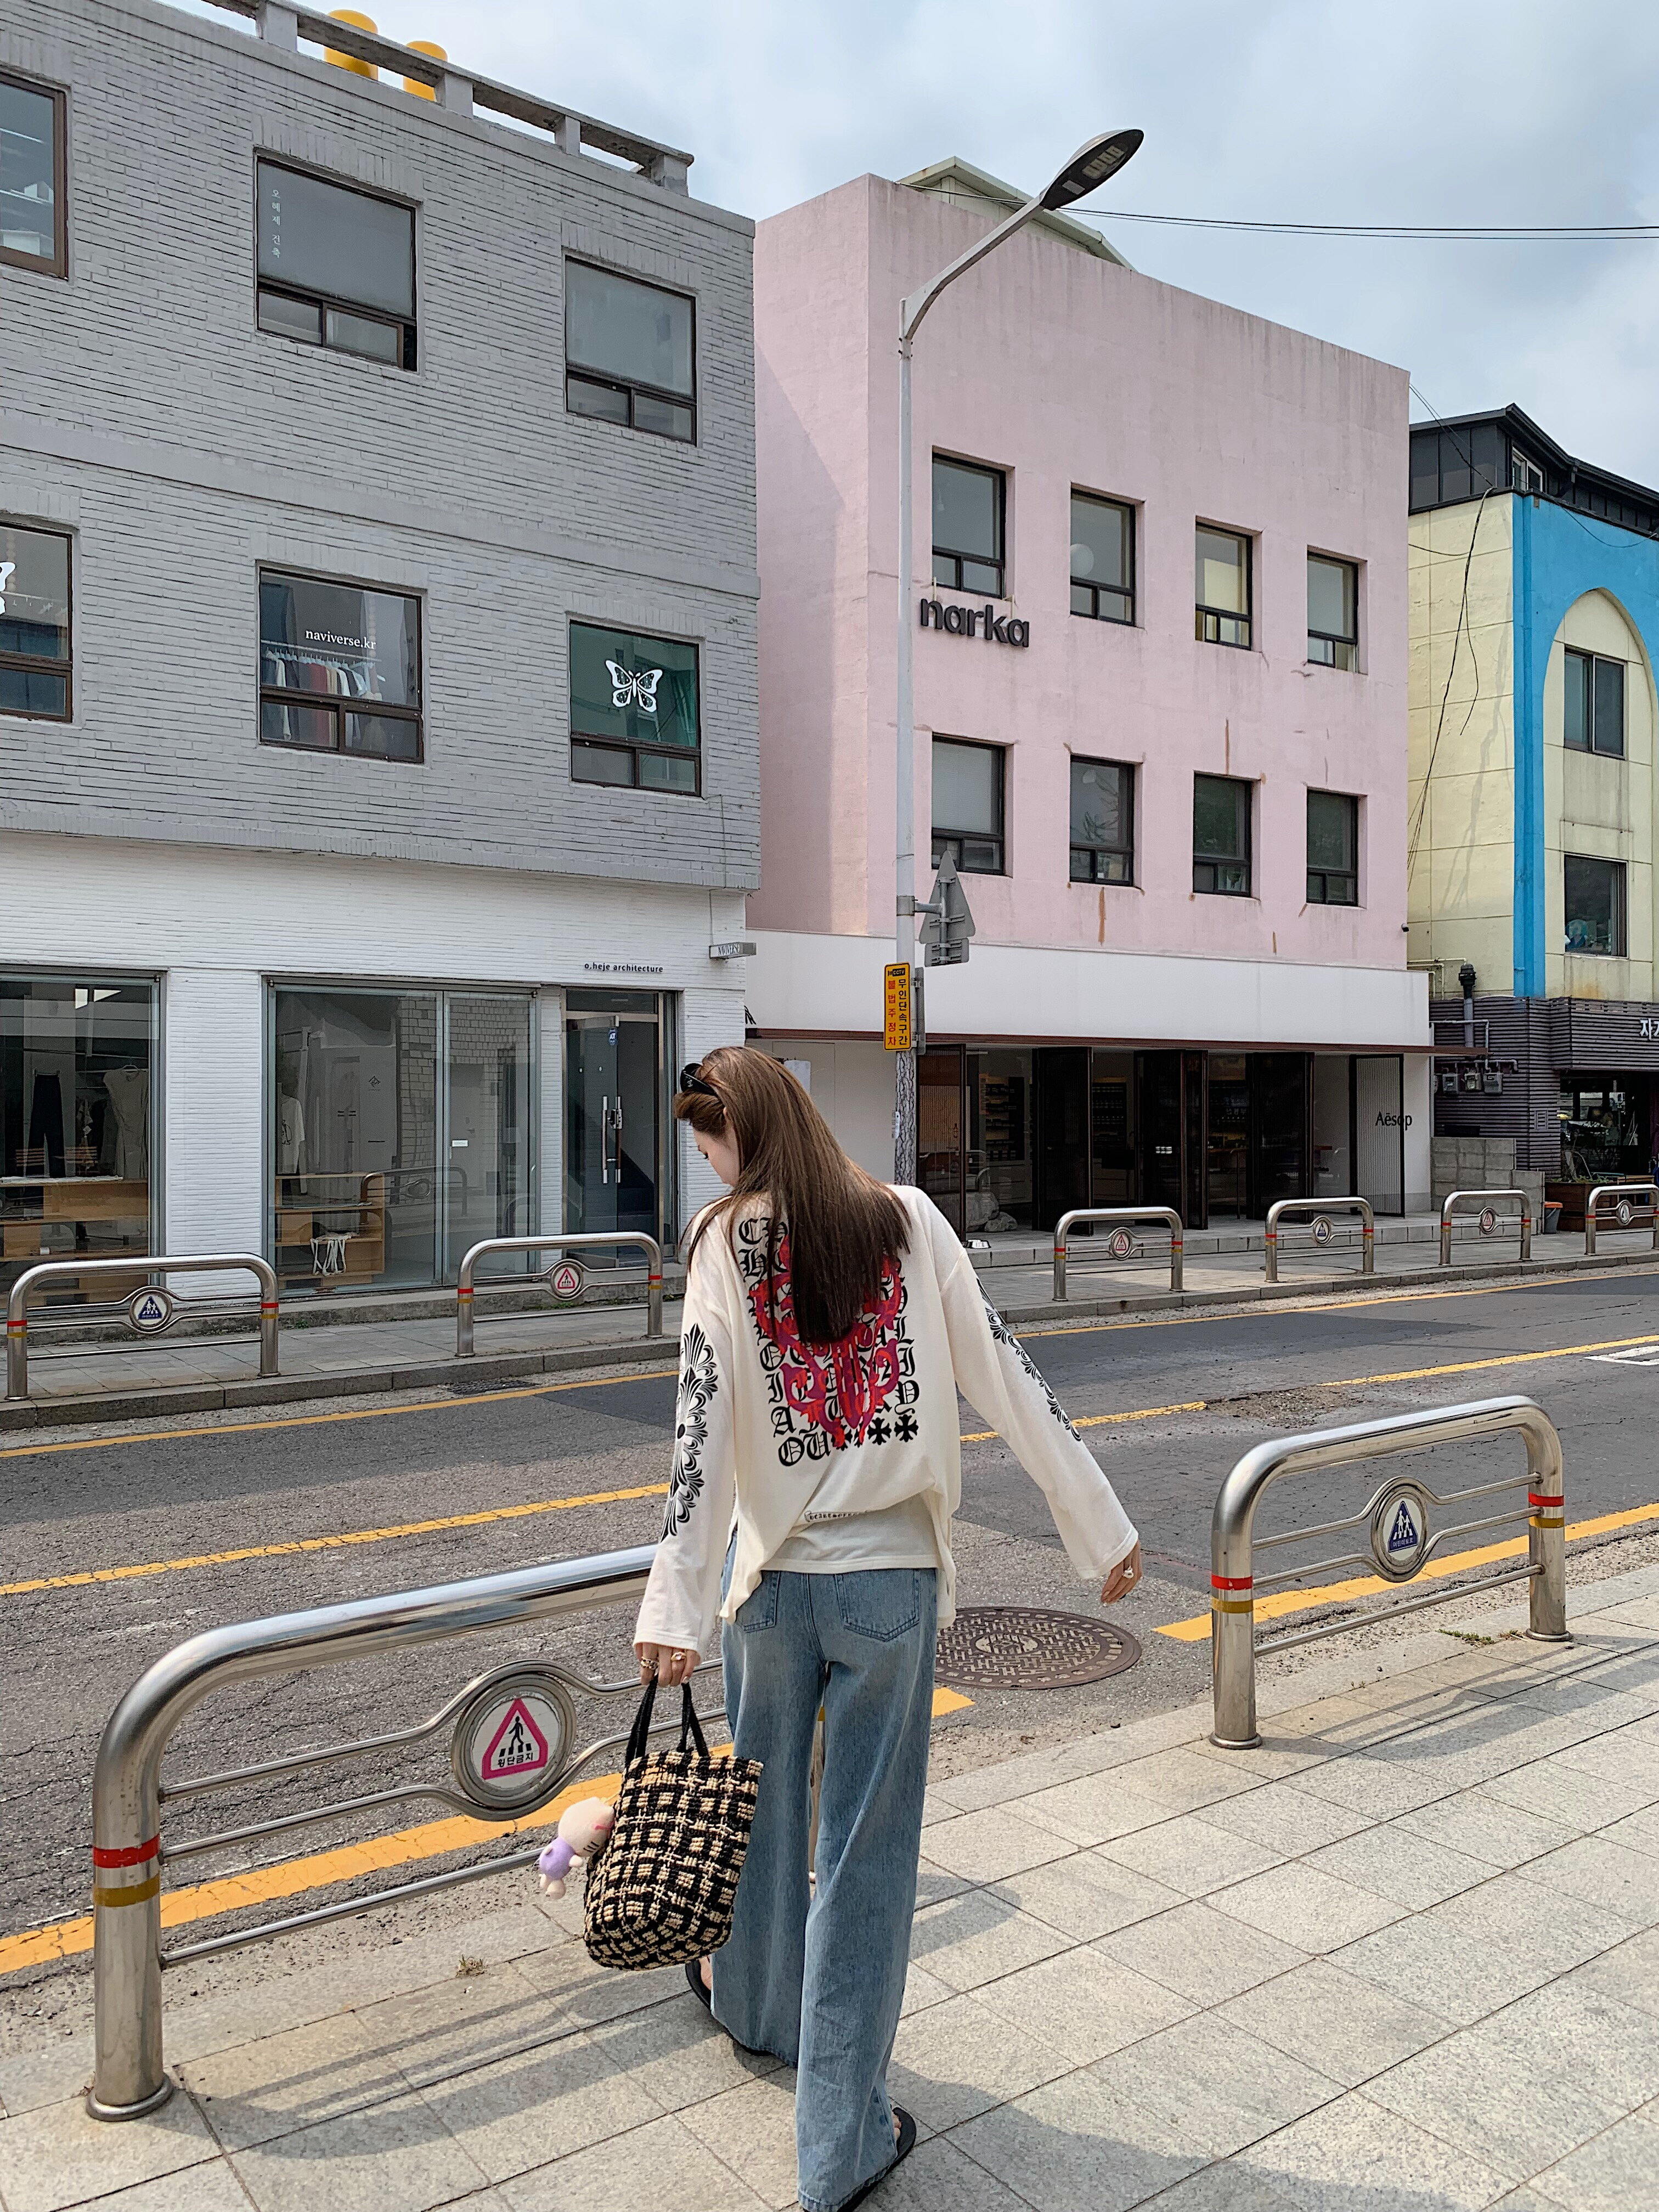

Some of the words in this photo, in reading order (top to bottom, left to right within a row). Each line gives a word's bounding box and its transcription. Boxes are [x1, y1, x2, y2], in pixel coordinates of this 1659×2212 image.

[921, 599, 1029, 647] narka
[305, 630, 376, 650] naviverse.kr
[584, 962, 610, 971] o.heje
[613, 964, 663, 972] architecture
[898, 979, 909, 1046] 무인단속구간
[497, 1753, 534, 1768] 횡단금지
